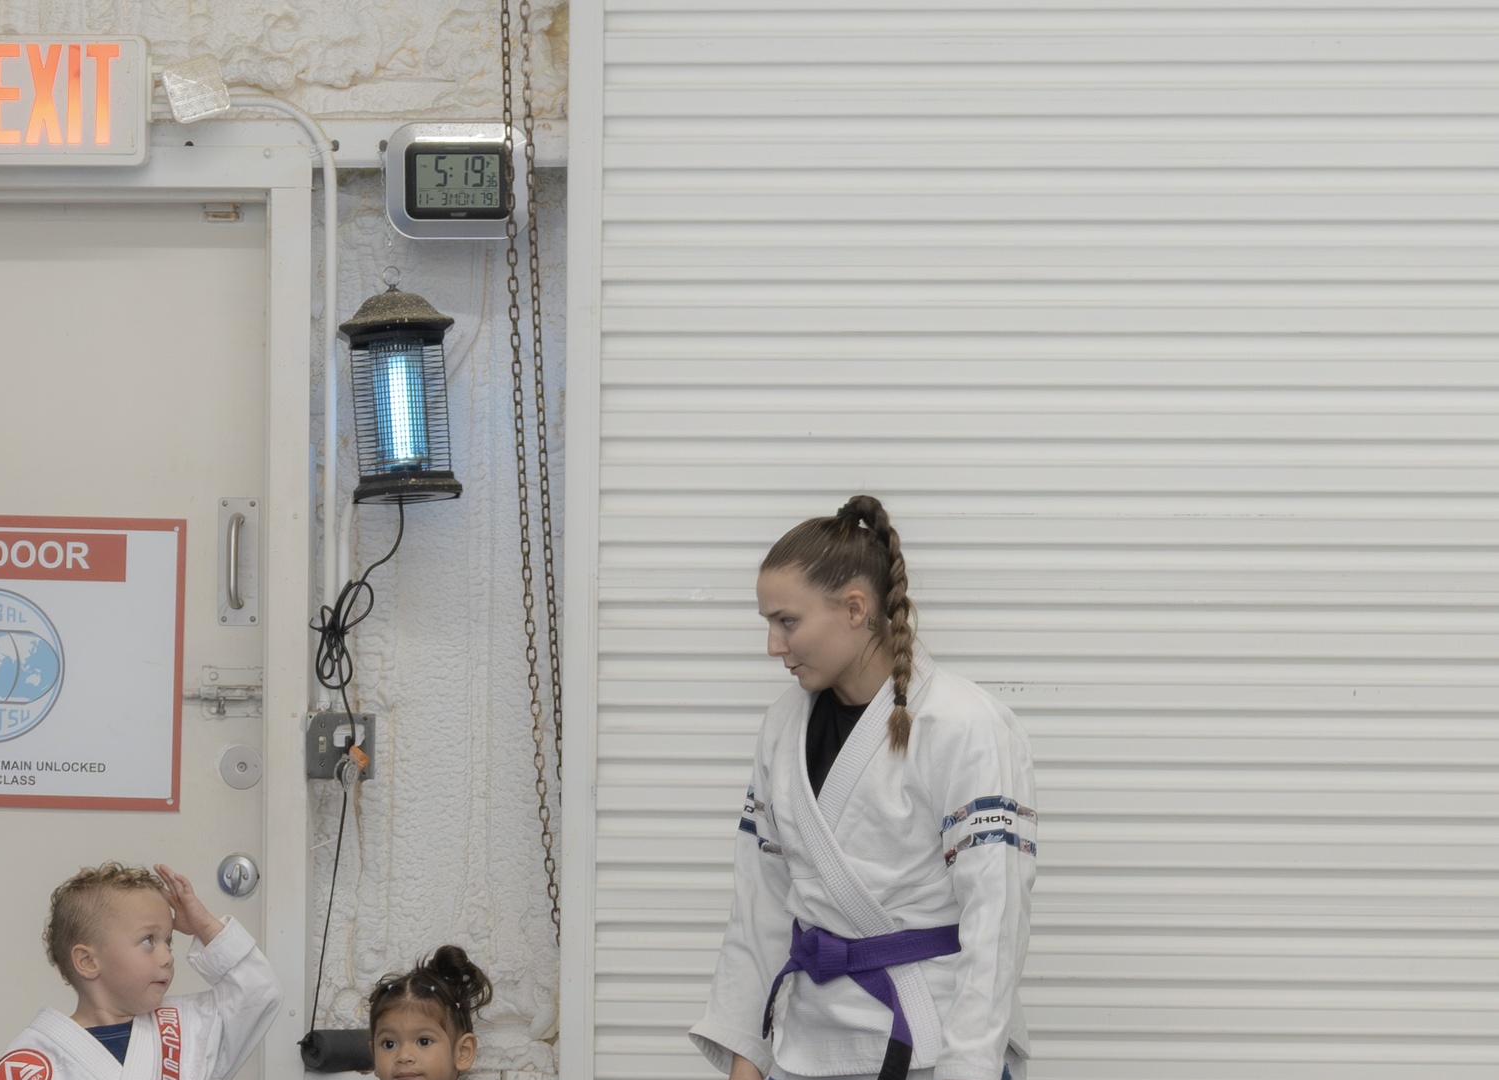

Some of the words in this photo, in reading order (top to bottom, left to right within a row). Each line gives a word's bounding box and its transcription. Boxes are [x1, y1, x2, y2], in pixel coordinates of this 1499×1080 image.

[434, 155, 485, 188] 5:19
[36, 761, 107, 773] UNLOCKED
[156, 1008, 180, 1073] GRACIE
